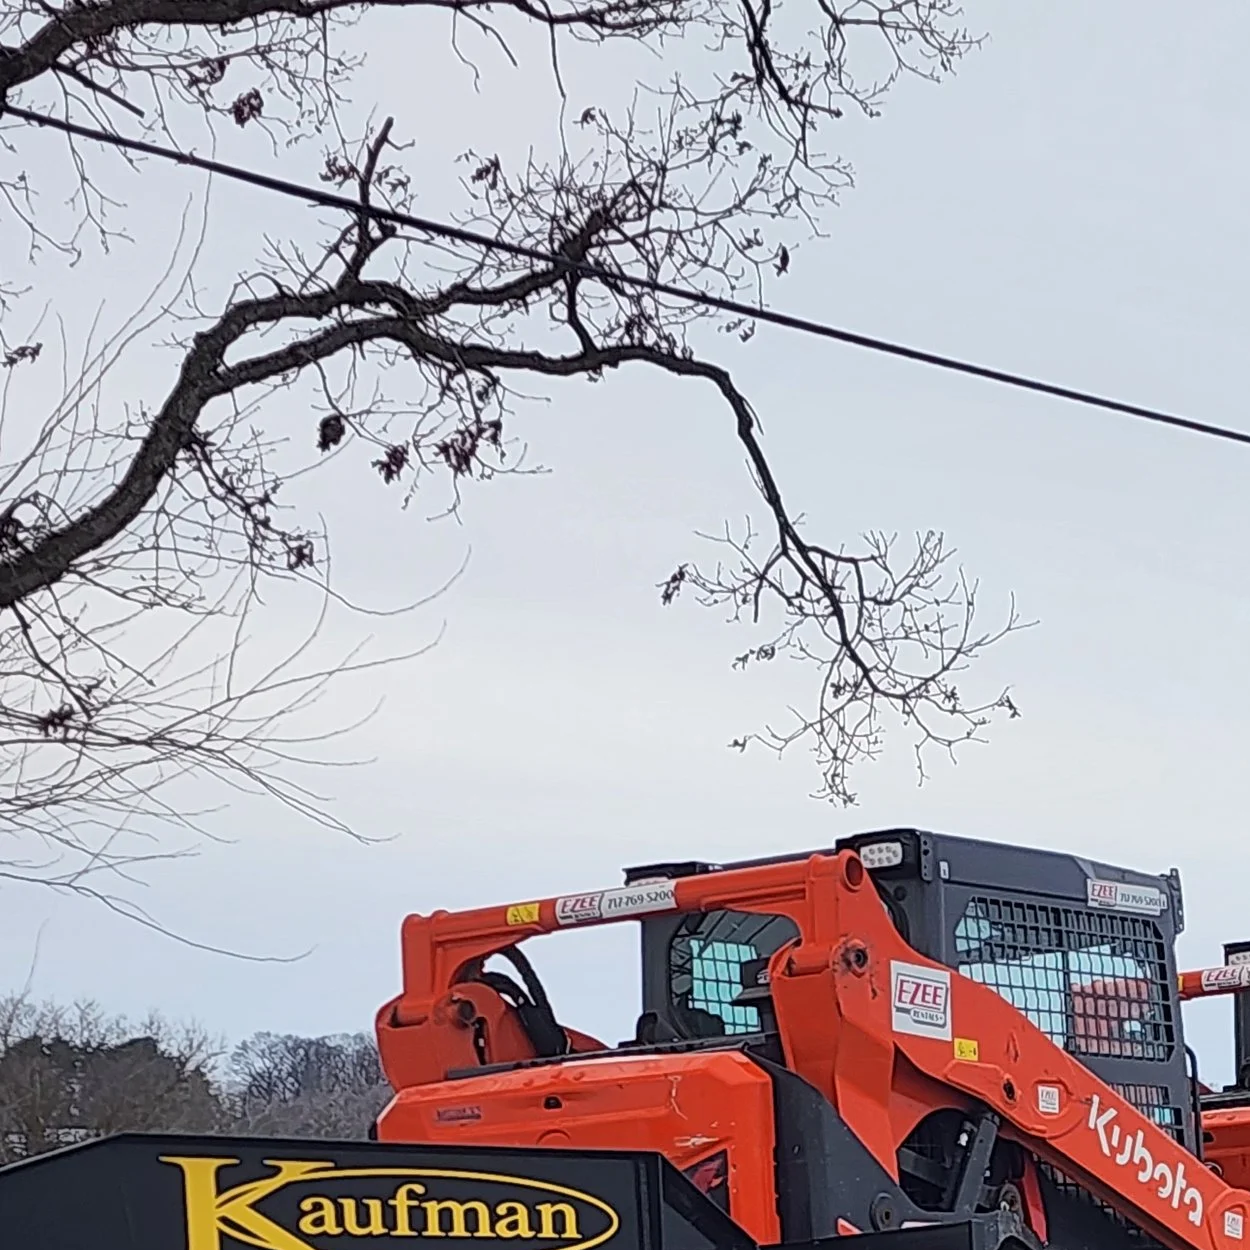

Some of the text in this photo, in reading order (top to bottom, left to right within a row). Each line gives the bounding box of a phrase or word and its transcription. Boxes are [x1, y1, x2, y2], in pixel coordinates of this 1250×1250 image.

[1092, 883, 1114, 898] EZEE
[561, 895, 599, 914] EZEE
[1206, 968, 1238, 982] EZEE
[898, 979, 944, 1010] EZEE
[1088, 1094, 1203, 1227] Kubota
